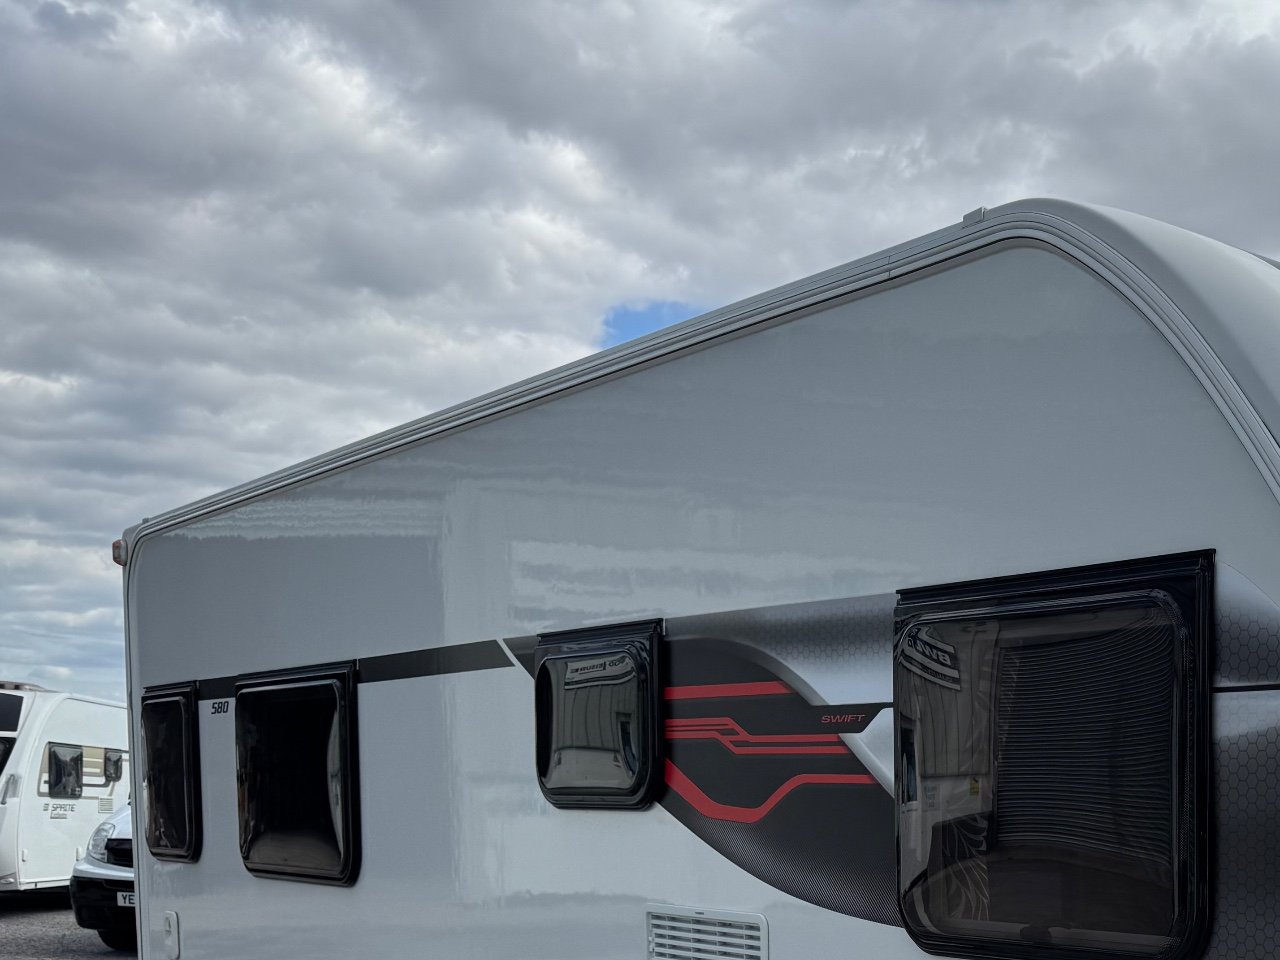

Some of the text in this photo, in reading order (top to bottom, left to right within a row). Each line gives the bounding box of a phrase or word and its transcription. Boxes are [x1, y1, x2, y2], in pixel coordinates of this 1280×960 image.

[211, 700, 229, 715] 580
[821, 714, 866, 723] SWIFT
[51, 803, 77, 812] SPRITE
